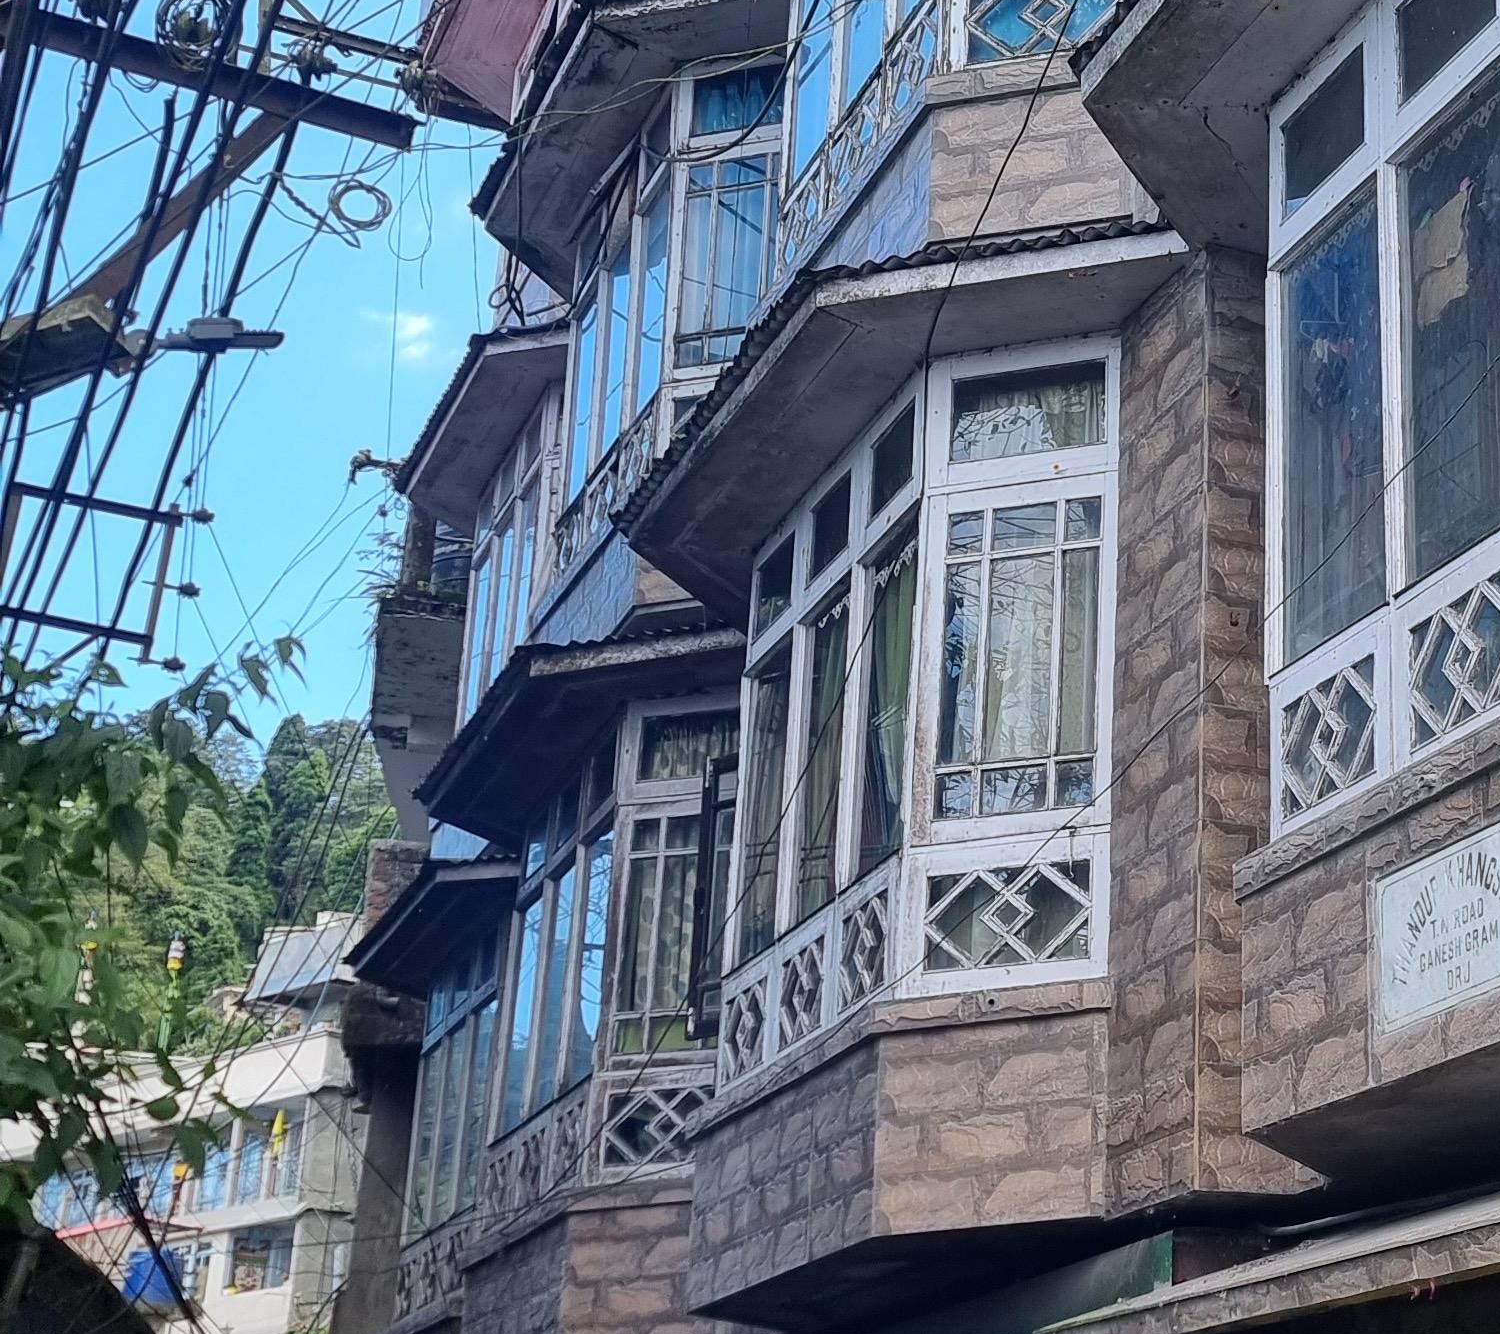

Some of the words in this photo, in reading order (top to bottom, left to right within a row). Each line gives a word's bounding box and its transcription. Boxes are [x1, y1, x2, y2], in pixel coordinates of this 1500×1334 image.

[1419, 936, 1462, 973] GANESH
[1464, 918, 1499, 952] GRAM
[1446, 960, 1471, 991] DRJ
